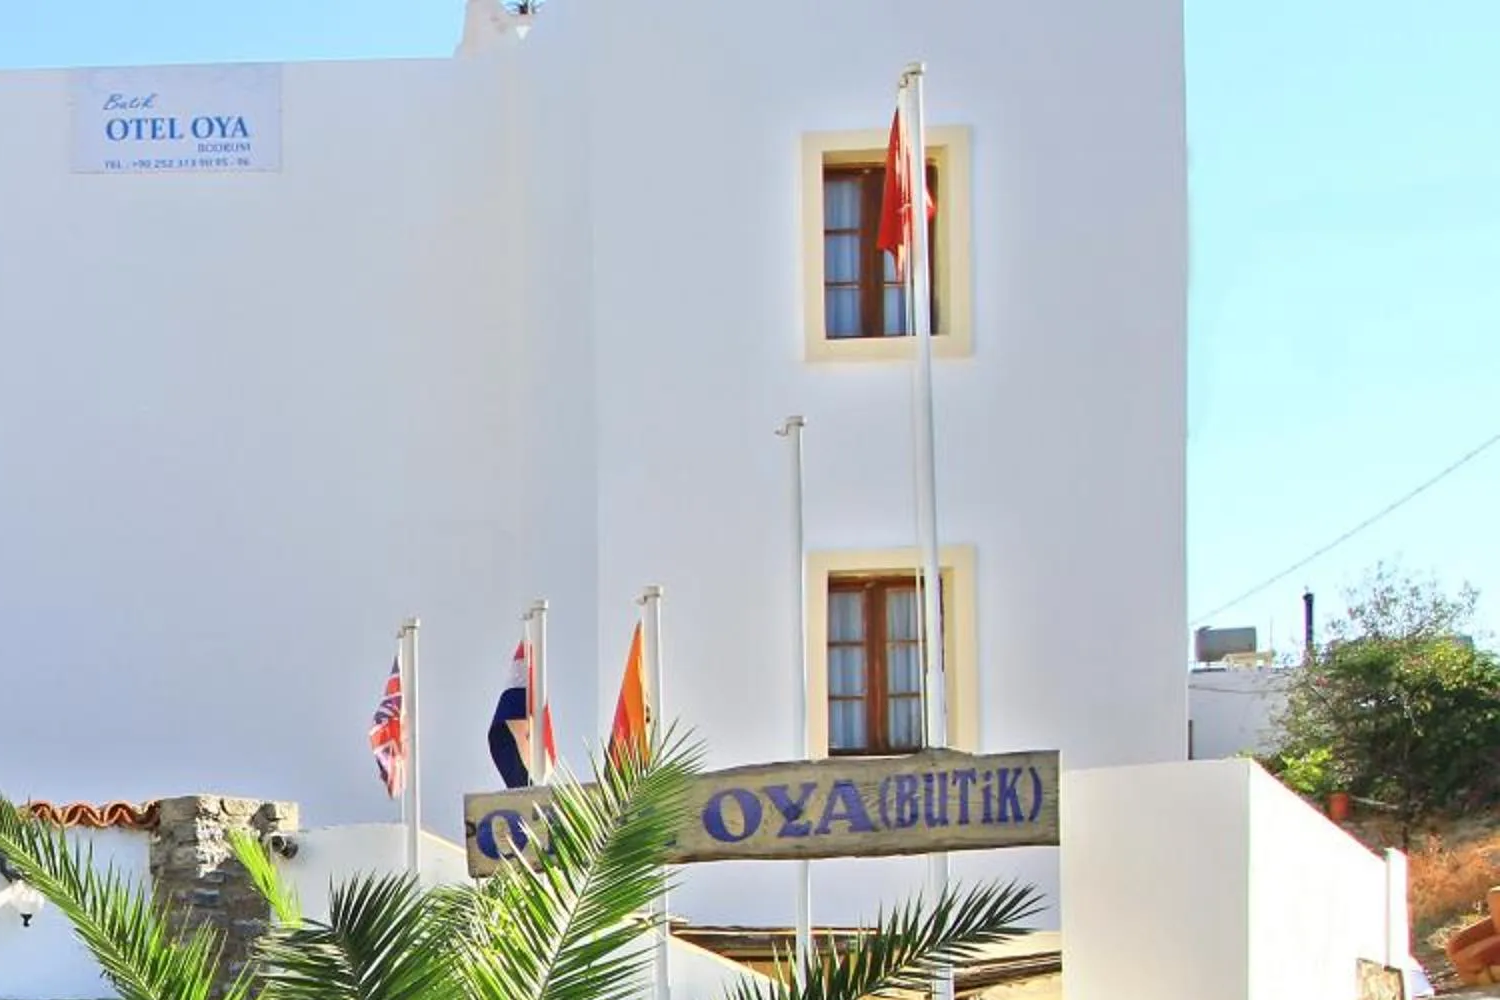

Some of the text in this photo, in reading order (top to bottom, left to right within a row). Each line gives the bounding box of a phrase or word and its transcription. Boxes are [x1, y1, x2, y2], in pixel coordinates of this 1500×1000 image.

[105, 116, 249, 141] OTEL OYA
[198, 143, 250, 153] BODRUM
[702, 780, 879, 843] OYA
